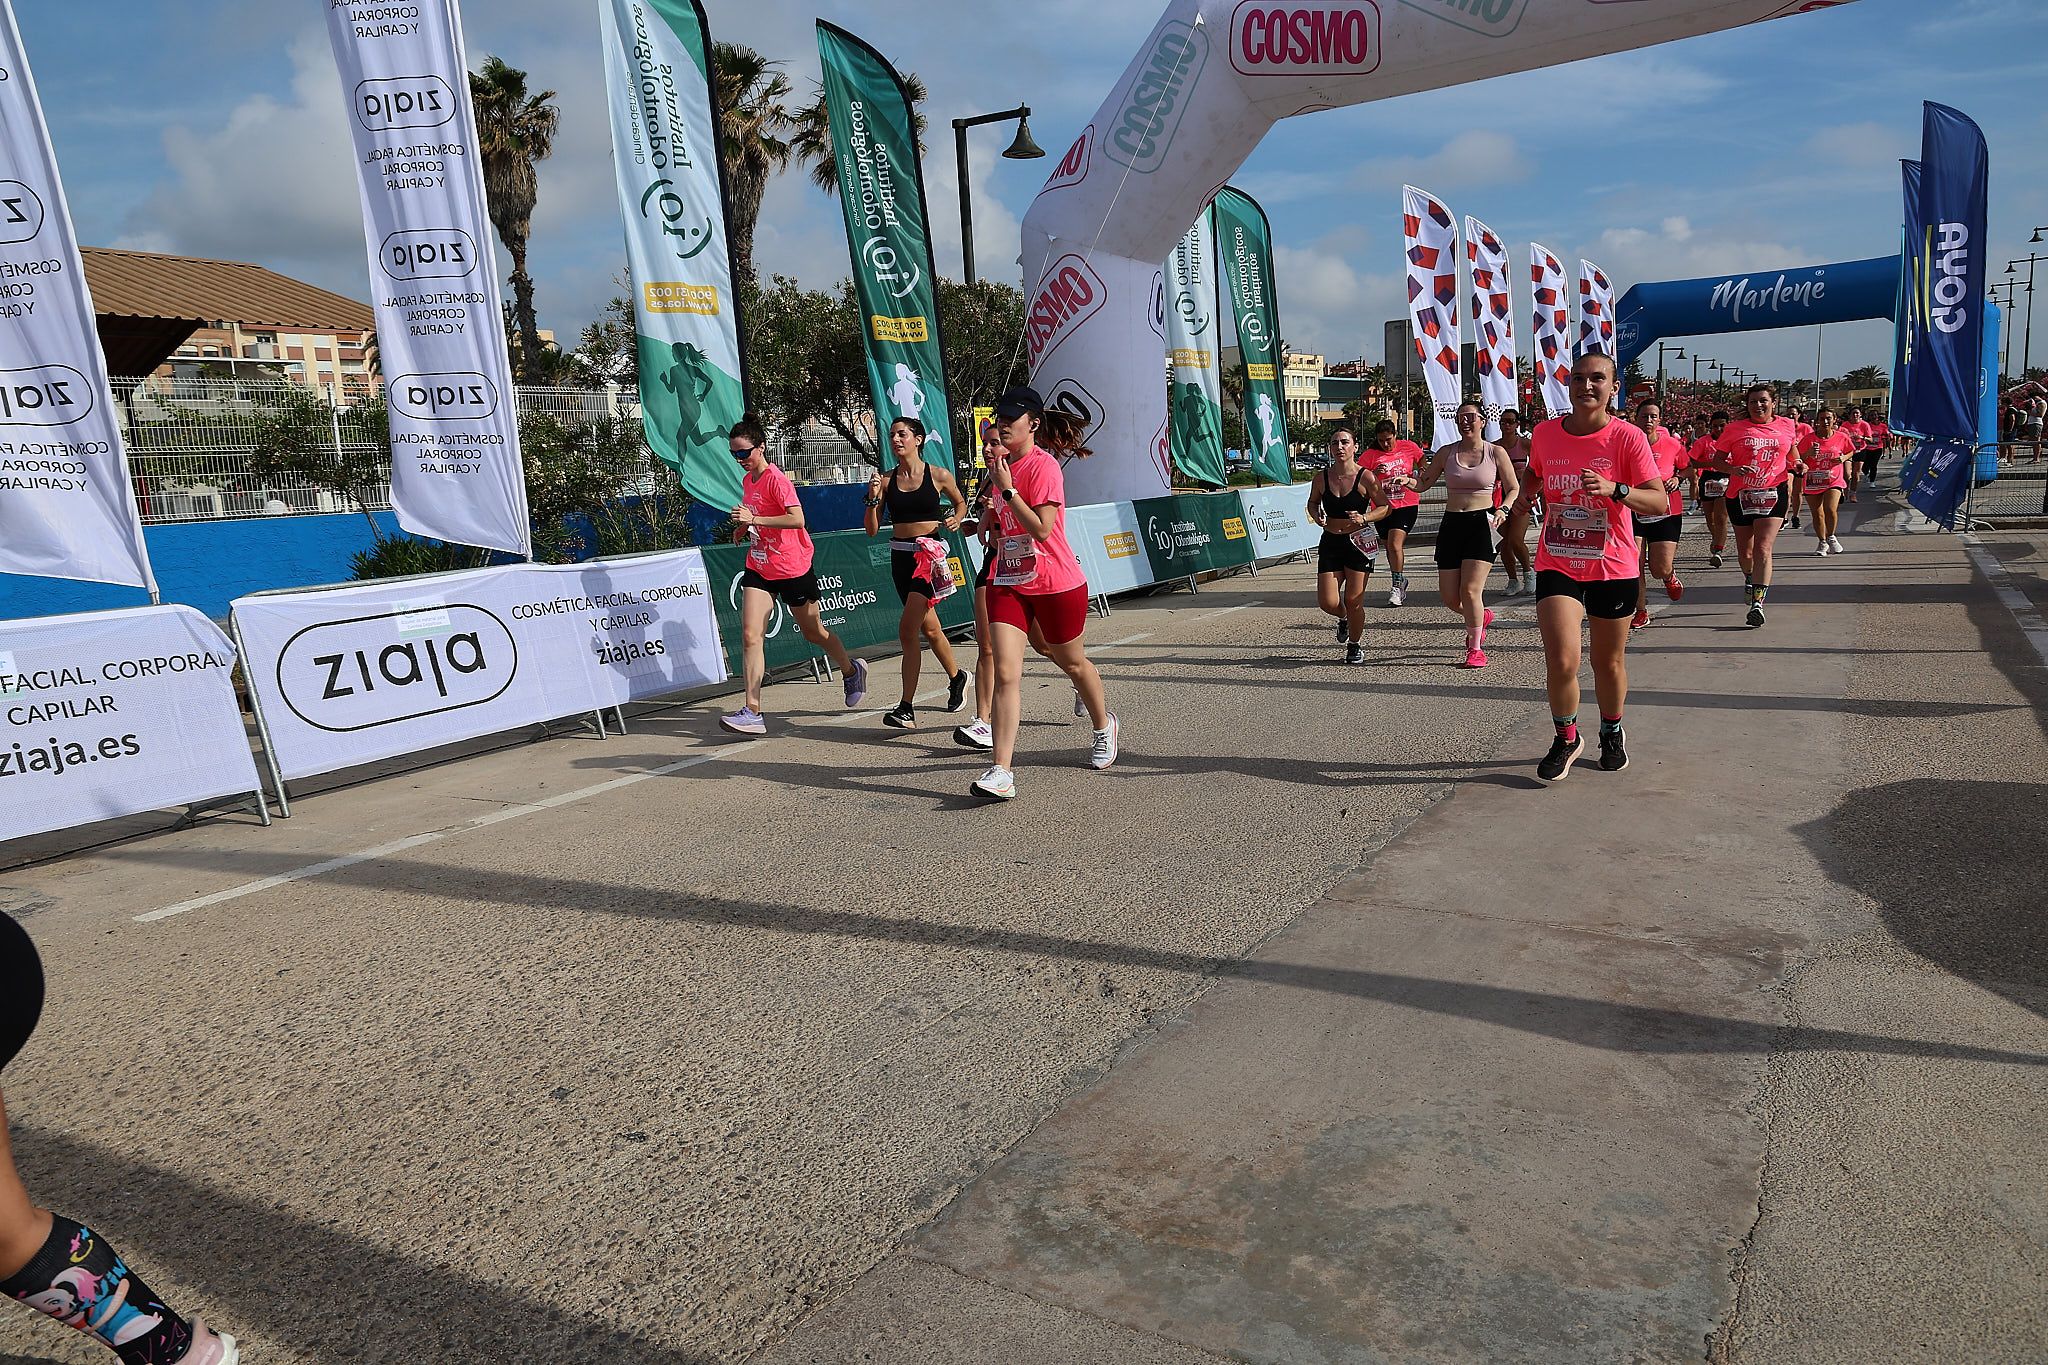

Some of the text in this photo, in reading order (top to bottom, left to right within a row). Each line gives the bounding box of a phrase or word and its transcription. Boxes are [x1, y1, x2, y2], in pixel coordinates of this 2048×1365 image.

[1242, 9, 1368, 65] COSMO
[1113, 33, 1197, 159] COSMO
[1710, 275, 1825, 323] Marlene
[1562, 528, 1586, 538] 016
[1006, 559, 1021, 568] 016
[511, 583, 704, 620] COSMÉTICA FACIAL, CORPORAL
[588, 612, 653, 632] Y CAPILAR
[102, 650, 226, 681] CORPORAL
[313, 631, 487, 700] ziaja
[596, 638, 665, 666] ziaja.es
[7, 695, 118, 726] CAPILAR
